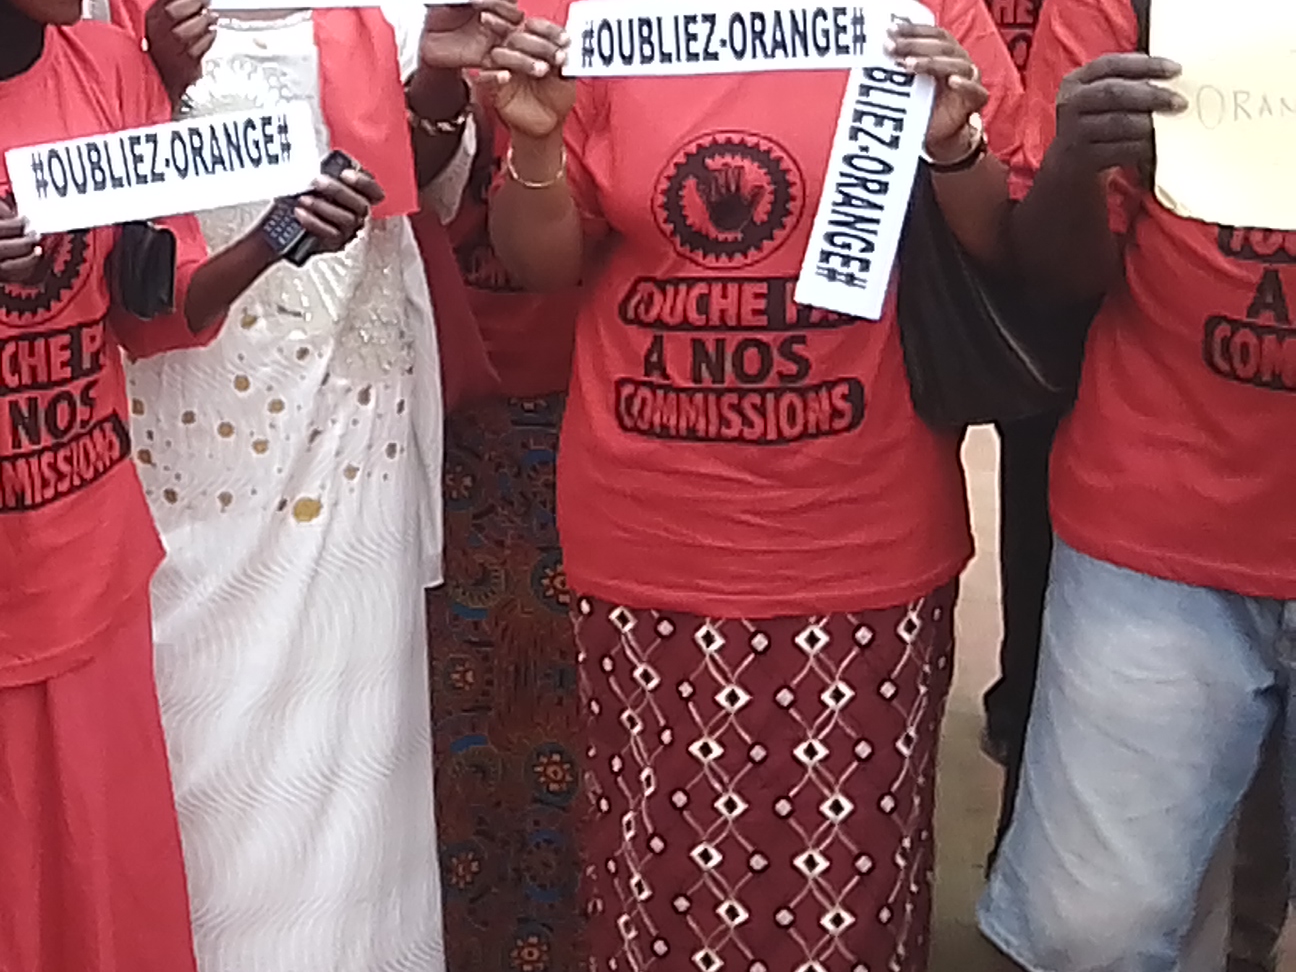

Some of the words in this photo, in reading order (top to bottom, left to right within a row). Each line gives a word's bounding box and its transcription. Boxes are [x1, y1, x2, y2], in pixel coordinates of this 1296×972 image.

[580, 6, 867, 68] #OUBLIEZ-ORANGE#
[31, 114, 293, 200] #OUBLIEZ-ORANGE#
[1245, 266, 1291, 325] A
[643, 333, 671, 381] A
[691, 334, 812, 386] NOS
[8, 379, 99, 451] NOS
[620, 382, 853, 442] COMMISSIONS
